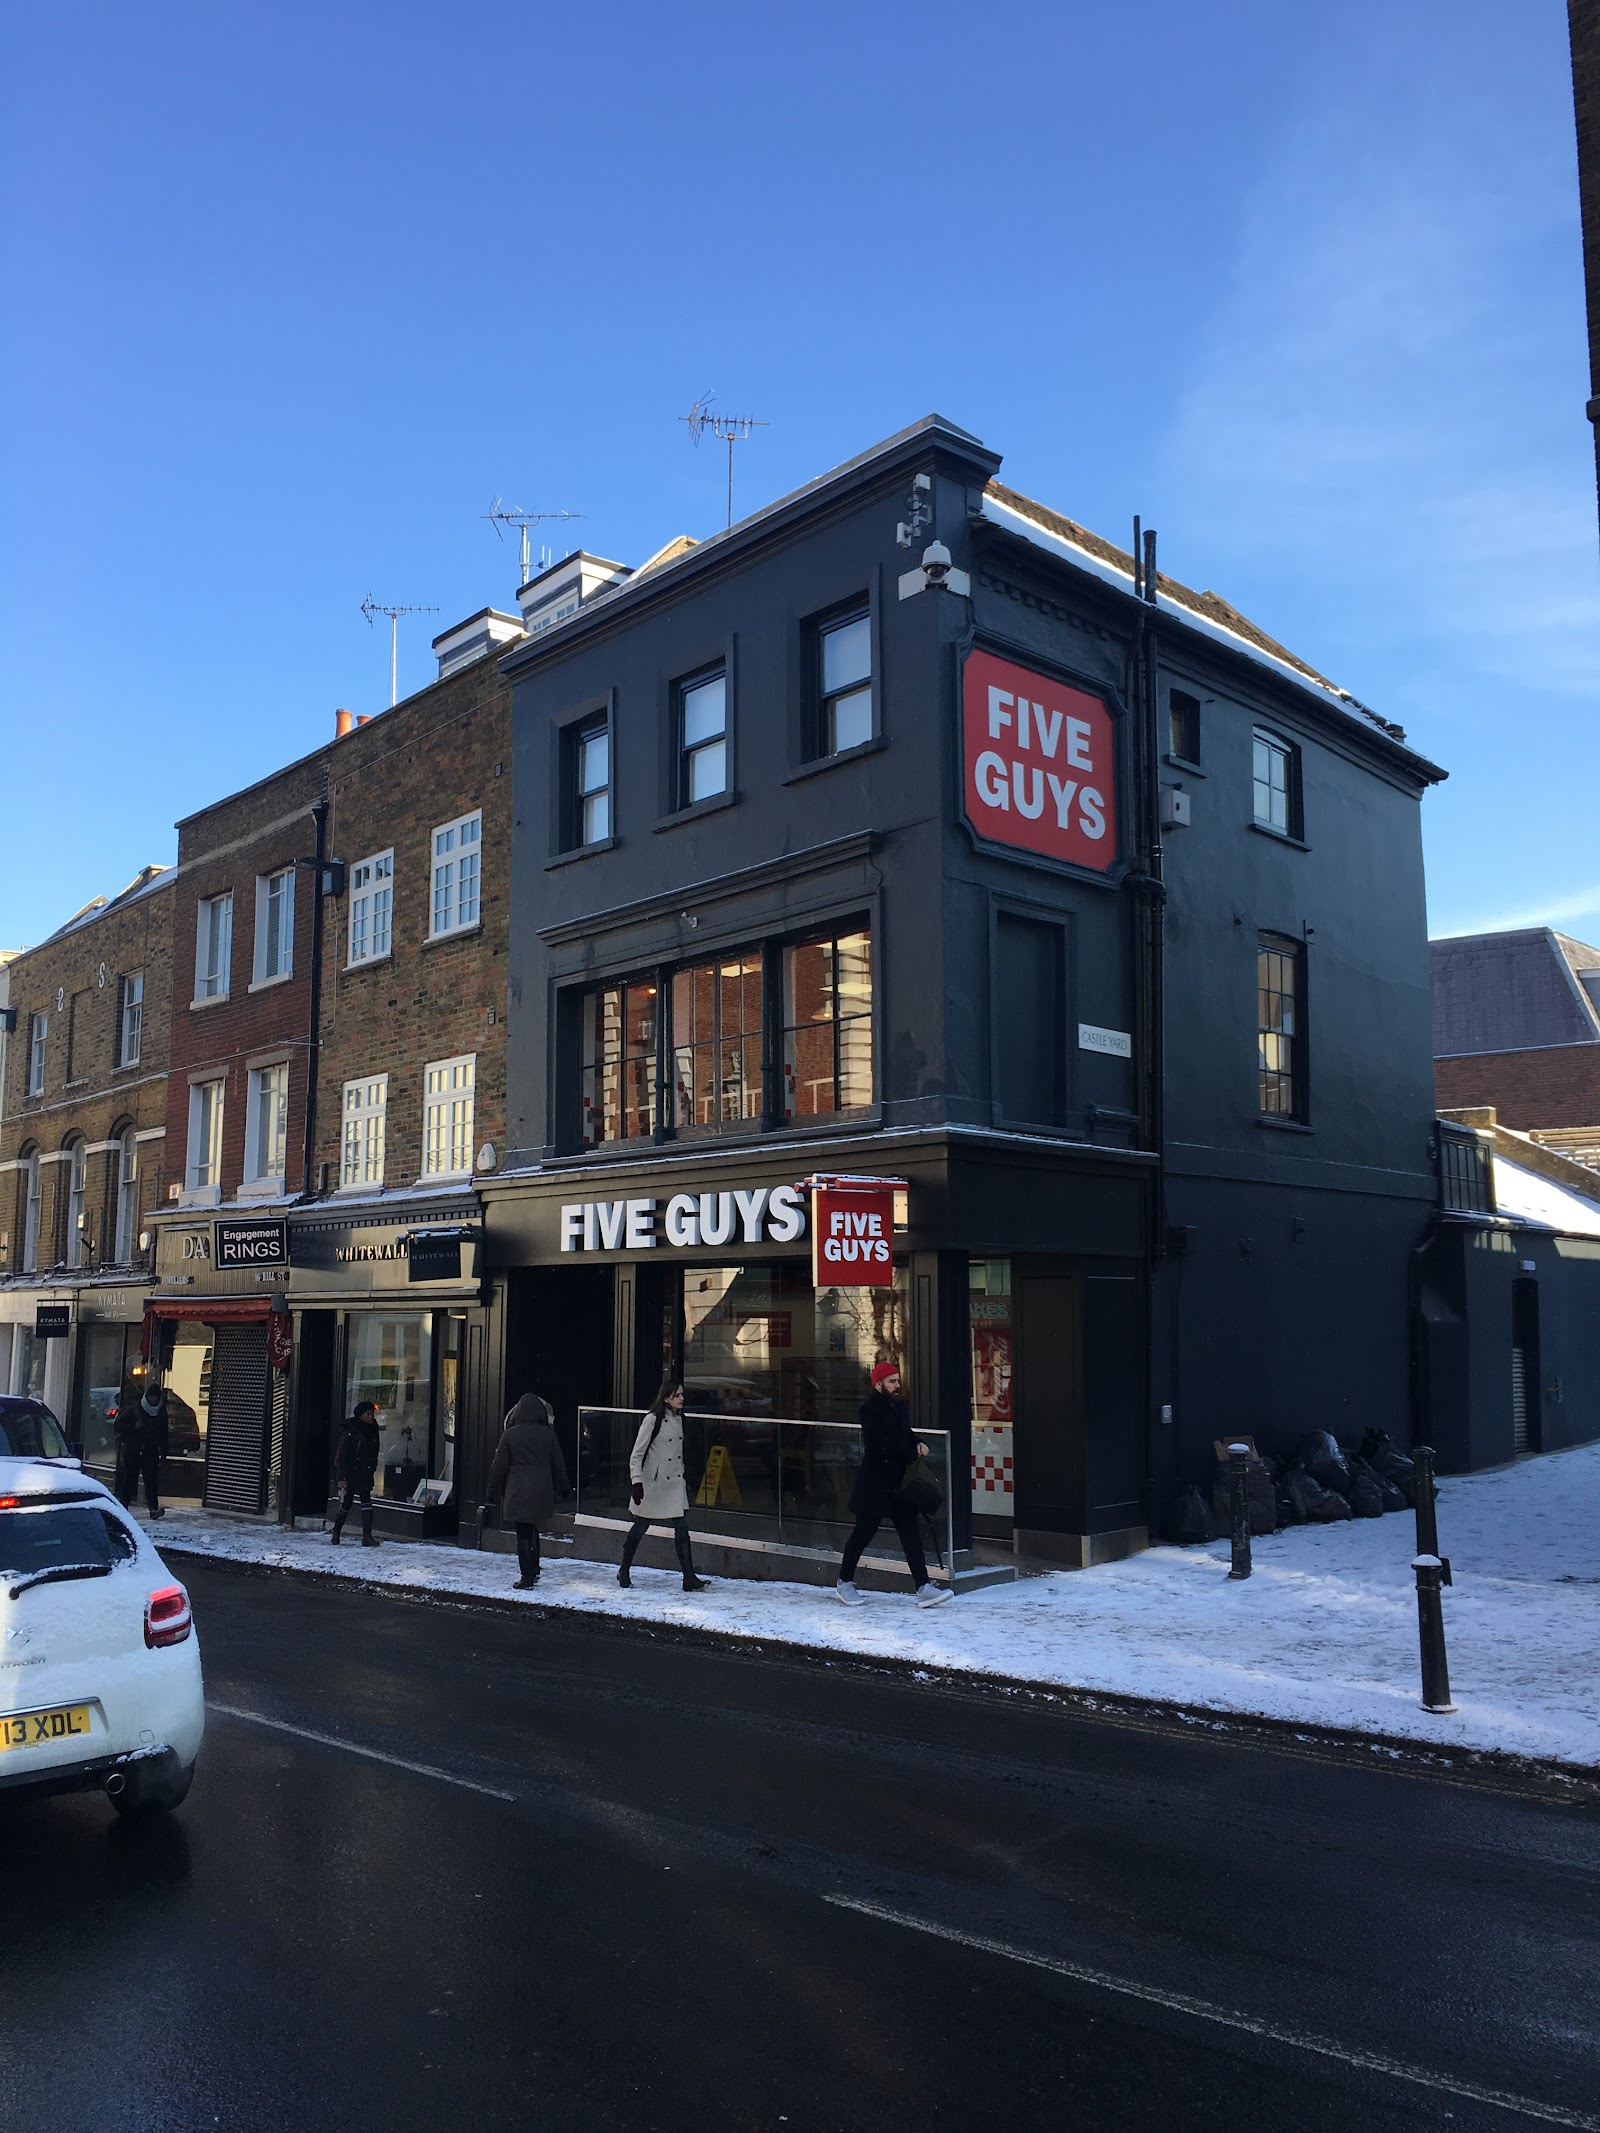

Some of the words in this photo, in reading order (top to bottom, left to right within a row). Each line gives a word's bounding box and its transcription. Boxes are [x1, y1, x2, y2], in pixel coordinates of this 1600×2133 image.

[987, 684, 1093, 773] FIVE
[974, 750, 1106, 840] GUYS
[1081, 1031, 1107, 1047] CASTLE
[1108, 1036, 1127, 1051] YARD
[560, 1197, 656, 1252] FIVE
[665, 1185, 806, 1247] GUYS
[830, 1211, 883, 1237] FIVE
[181, 1235, 210, 1259] DA
[223, 1228, 280, 1242] Engagement
[223, 1241, 281, 1260] RINGS
[335, 1243, 408, 1262] WHITEWALL
[411, 1251, 459, 1261] WHITEWALL
[824, 1237, 890, 1262] GUYS
[98, 1292, 126, 1307] KYMATA
[0, 1719, 27, 1745] 13
[34, 1711, 82, 1740] XDL
